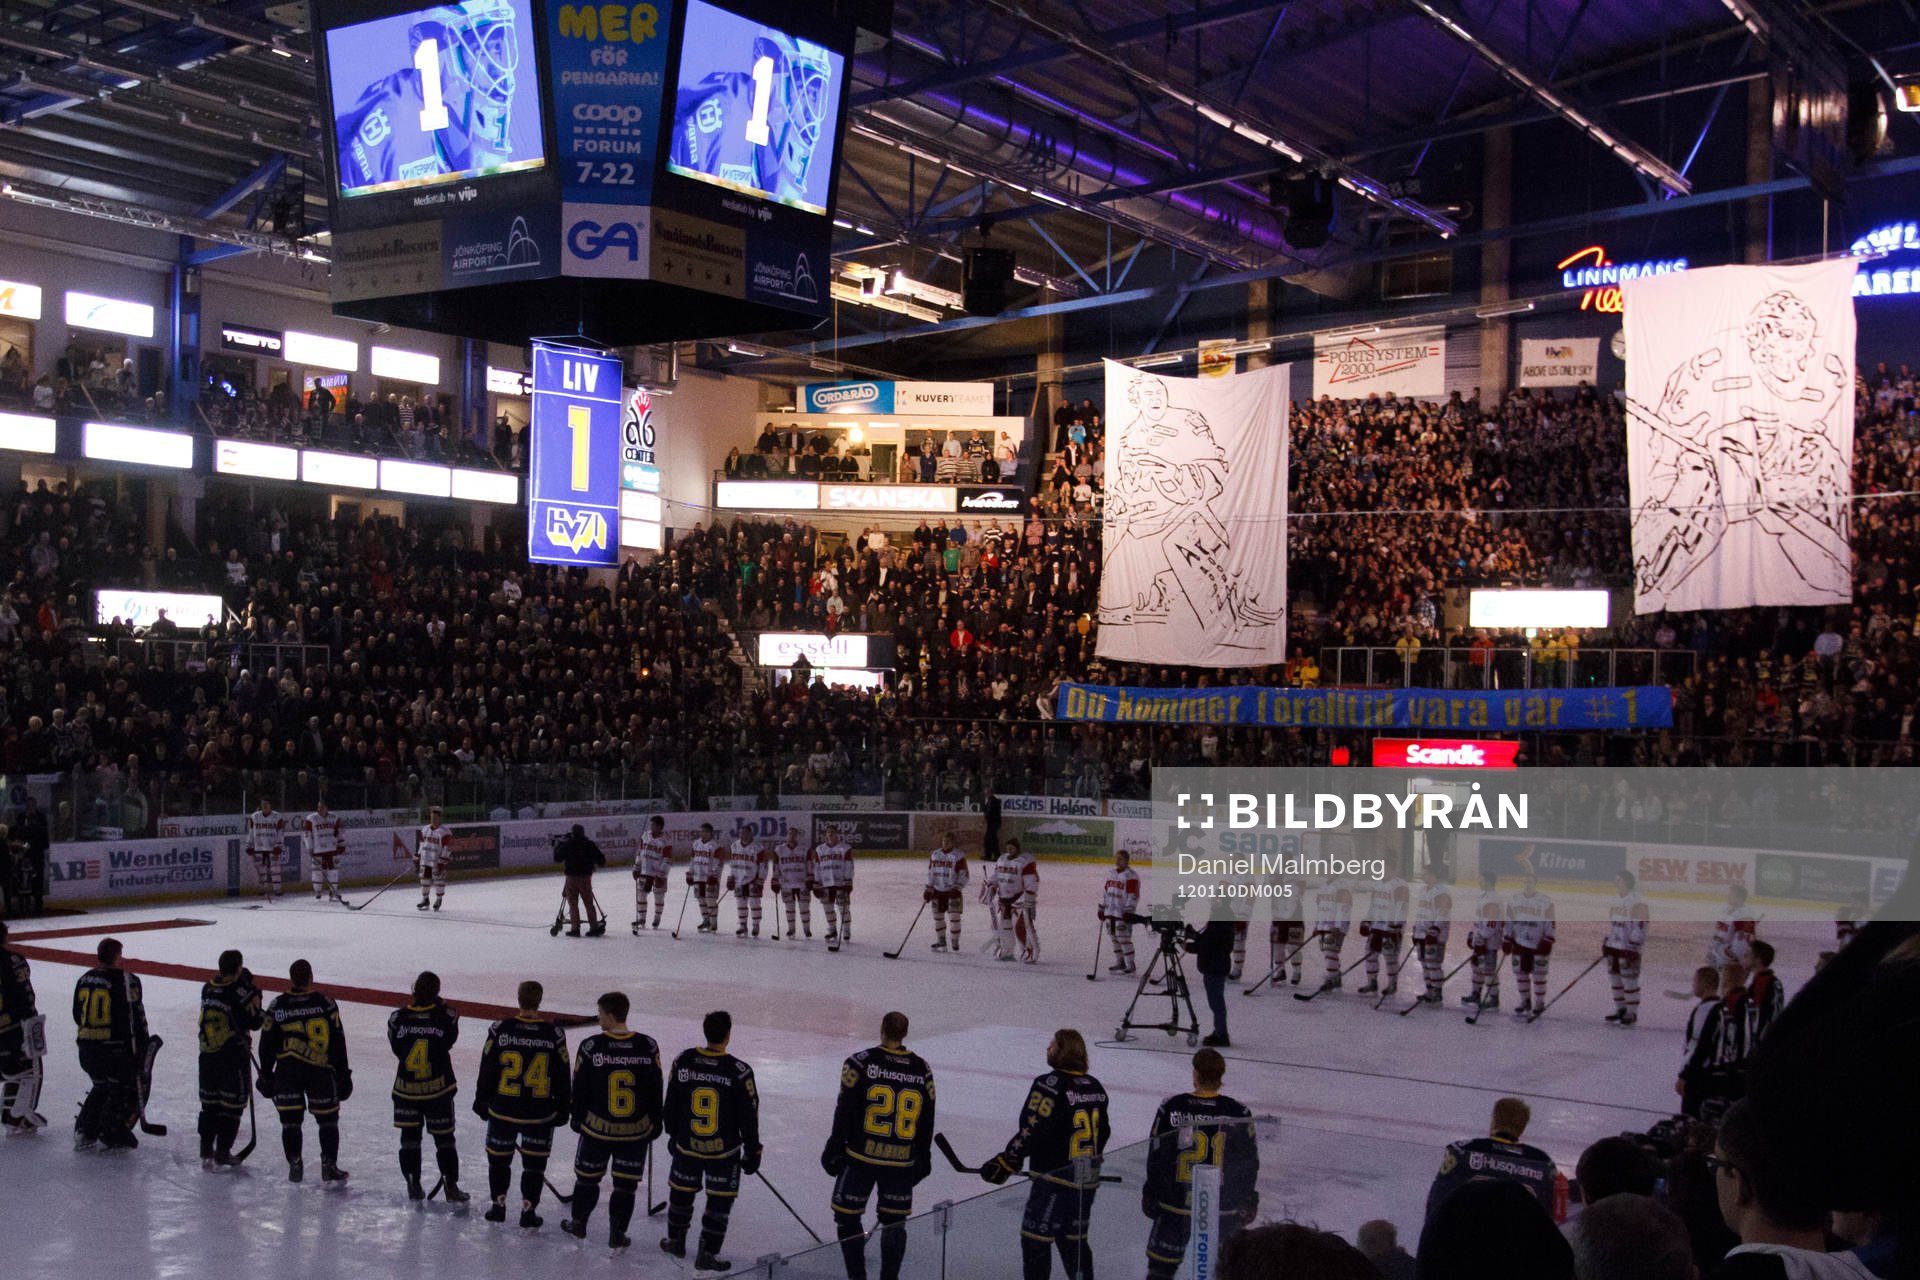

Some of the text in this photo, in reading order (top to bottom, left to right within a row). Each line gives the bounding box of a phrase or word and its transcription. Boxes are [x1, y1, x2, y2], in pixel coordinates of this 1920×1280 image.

[558, 4, 659, 44] MER
[590, 46, 629, 67] FÖR
[414, 38, 449, 132] 1
[745, 56, 775, 146] 1
[573, 139, 641, 154] FORUM
[577, 162, 635, 185] 7-22
[453, 241, 503, 258] JÖNKÖPING
[567, 220, 638, 261] GA
[453, 256, 493, 270] AIRPORT
[1329, 347, 1428, 364] PORTSYSTEM
[563, 359, 600, 393] LIV
[1341, 363, 1375, 375] 2000
[568, 404, 591, 492] 1
[829, 487, 946, 507] SKANSKA
[1067, 687, 1105, 720] Du
[1116, 688, 1242, 722] kommer
[1408, 697, 1488, 726] vara
[1406, 744, 1485, 766] Scandic
[184, 825, 238, 837] SCHENKER
[109, 847, 213, 868] Wendels
[1537, 852, 1586, 870] Kitron
[1638, 858, 1689, 876] SEW
[1696, 860, 1747, 880] SEW
[509, 1036, 554, 1049] Husqvarna
[405, 1039, 432, 1081] 4
[603, 1053, 652, 1065] Husqvarna
[497, 1050, 550, 1098] 24
[689, 1070, 732, 1087] Husqvarna
[608, 1069, 636, 1118] 6
[690, 1086, 720, 1137] 9
[863, 1083, 923, 1140] 28
[1484, 1157, 1544, 1181] Husqvarna
